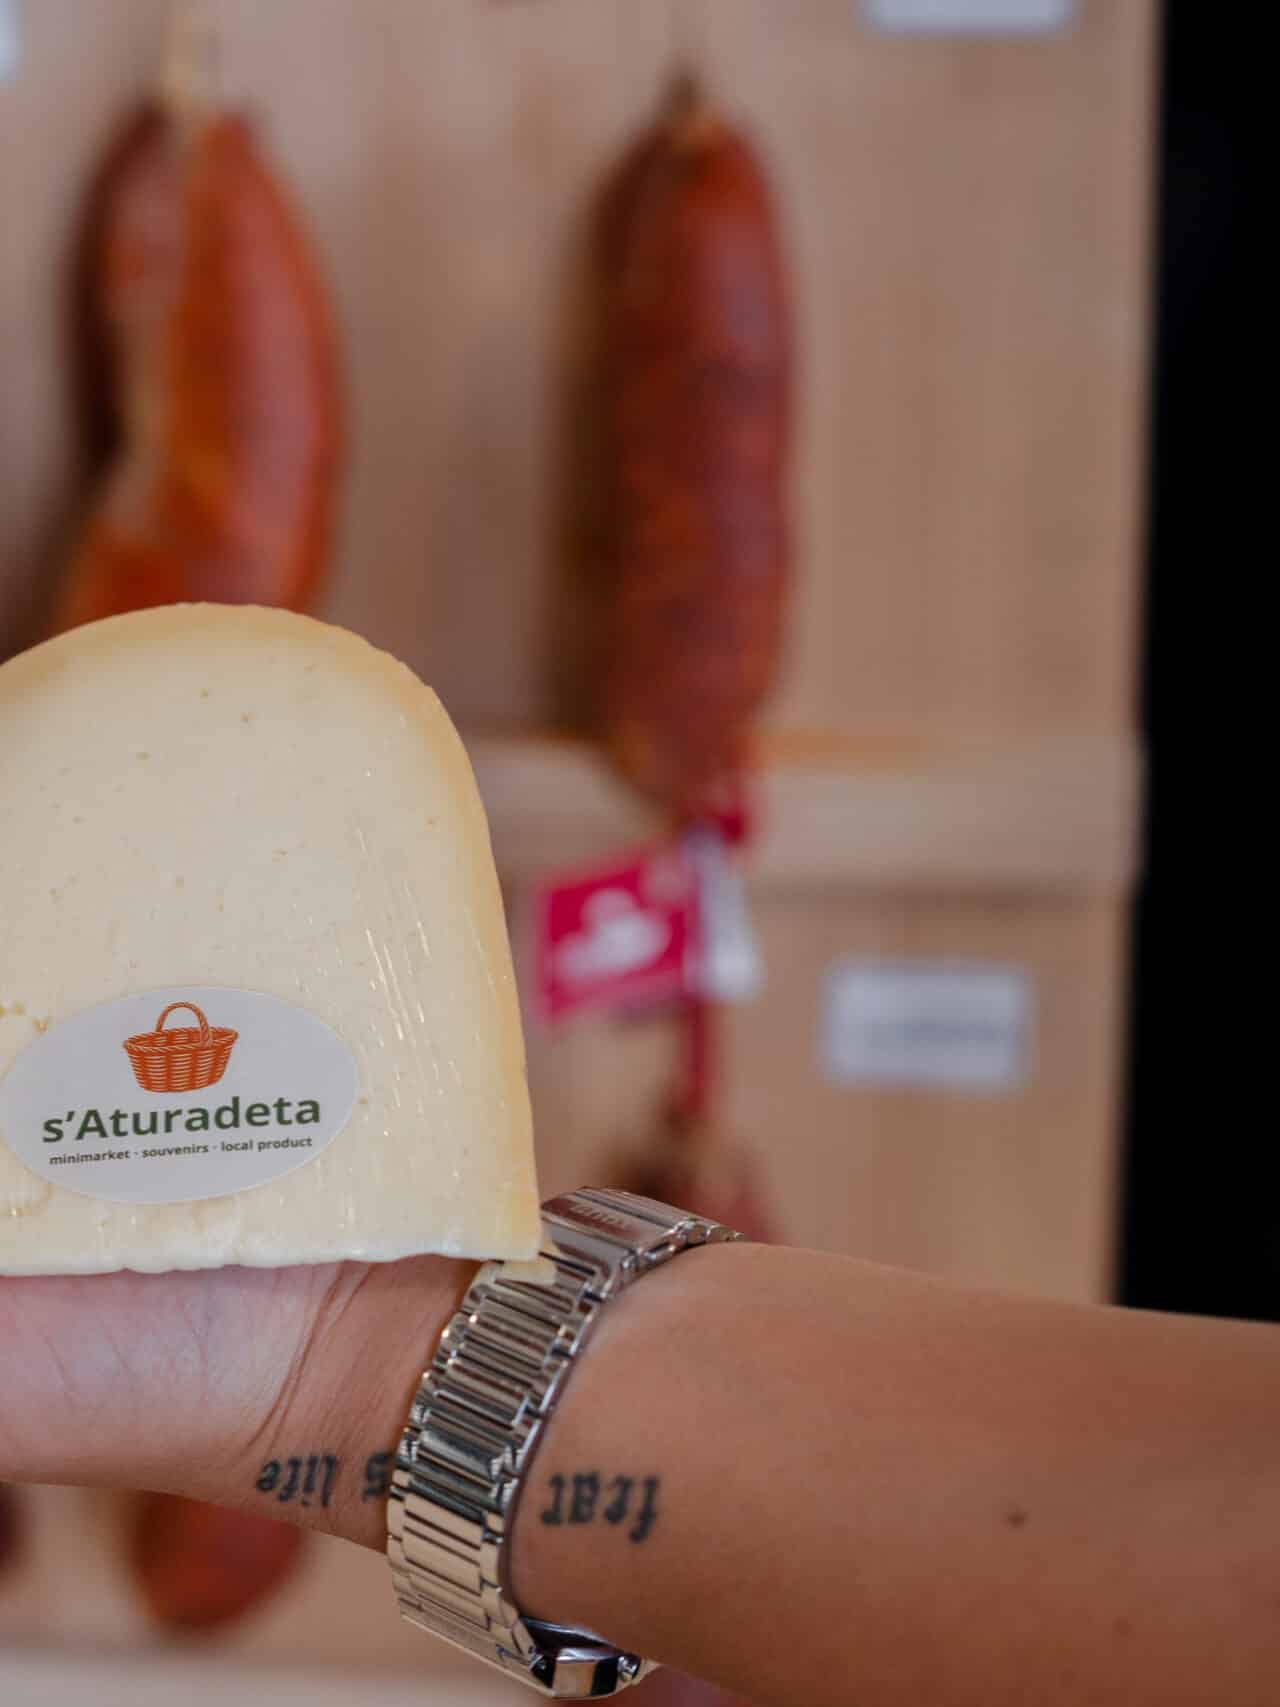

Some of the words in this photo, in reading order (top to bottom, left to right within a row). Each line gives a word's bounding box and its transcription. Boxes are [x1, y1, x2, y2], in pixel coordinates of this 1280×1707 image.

[42, 1096, 322, 1144] s'Aturadeta
[48, 1149, 131, 1165] minimarket
[141, 1143, 210, 1159] souvenirs
[220, 1139, 254, 1152] local
[257, 1136, 313, 1153] product
[255, 1453, 339, 1509] life
[540, 1470, 663, 1546] fear
